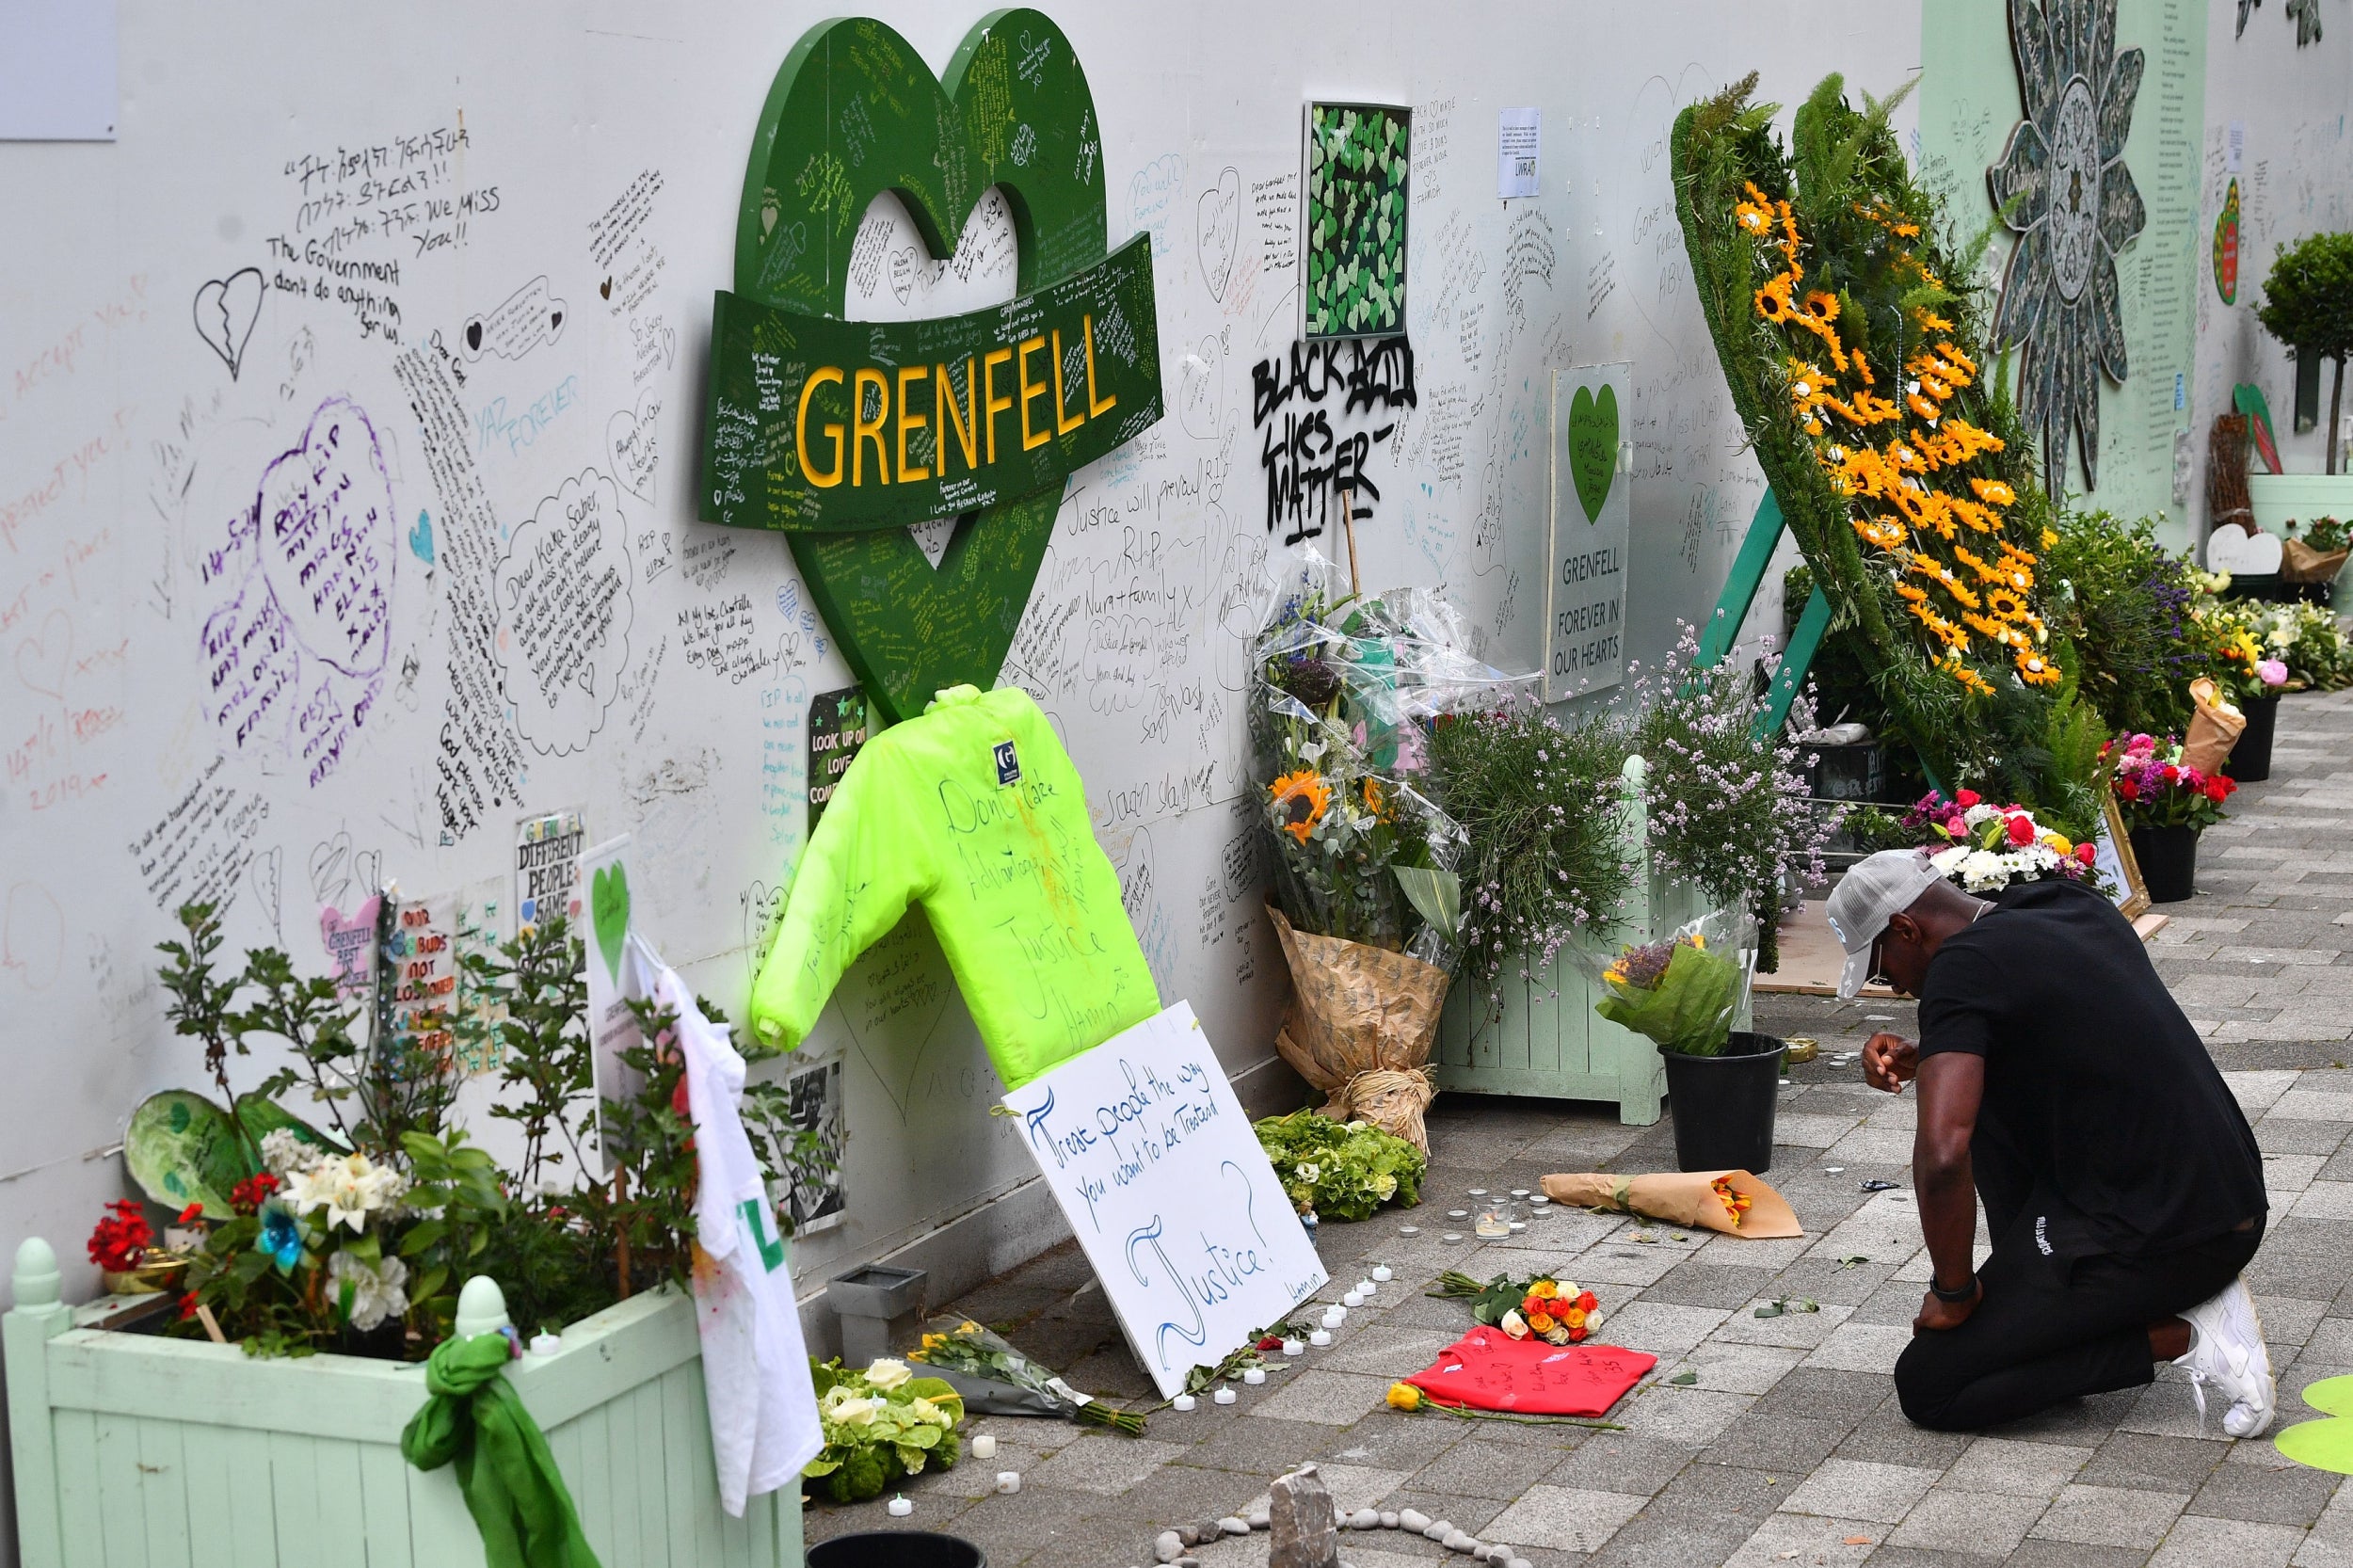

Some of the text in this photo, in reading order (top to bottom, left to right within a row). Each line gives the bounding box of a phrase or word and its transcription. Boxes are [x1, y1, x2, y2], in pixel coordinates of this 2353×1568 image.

[1439, 96, 1456, 114] MADE
[426, 200, 453, 221] We
[266, 234, 399, 286] The Government
[275, 270, 401, 325] don't do anything
[360, 311, 379, 339] for
[795, 313, 1116, 488] GRENFELL
[1252, 340, 1345, 429] BLACK
[1060, 458, 1202, 536] Justice will prevail
[1267, 432, 1380, 535] MATTER
[505, 560, 535, 611] Dear
[536, 531, 567, 573] Kaka
[524, 589, 538, 614] all
[539, 567, 557, 595] miss
[557, 546, 572, 571] you
[572, 519, 601, 554] dearly
[1562, 546, 1619, 585] GRENFELL
[539, 614, 559, 643] have
[573, 570, 594, 600] you
[1558, 598, 1619, 638] FOREVER IN
[520, 624, 536, 648] and
[553, 616, 576, 649] smile
[1554, 634, 1619, 676] OUR HEARTS
[812, 733, 839, 752] LOOK
[842, 730, 854, 748] UP
[827, 755, 852, 775] LOVE
[518, 831, 584, 870] DIFFERENT
[527, 863, 574, 899] PEOPLE
[402, 909, 431, 928] OUR
[535, 893, 568, 924] SAME
[408, 959, 435, 979] NOT
[1095, 1057, 1152, 1162] people
[1146, 1064, 1176, 1103] the
[1177, 1061, 1210, 1093] way
[1112, 1142, 1145, 1191] want
[1143, 1138, 1161, 1160] to
[1164, 1122, 1178, 1148] be
